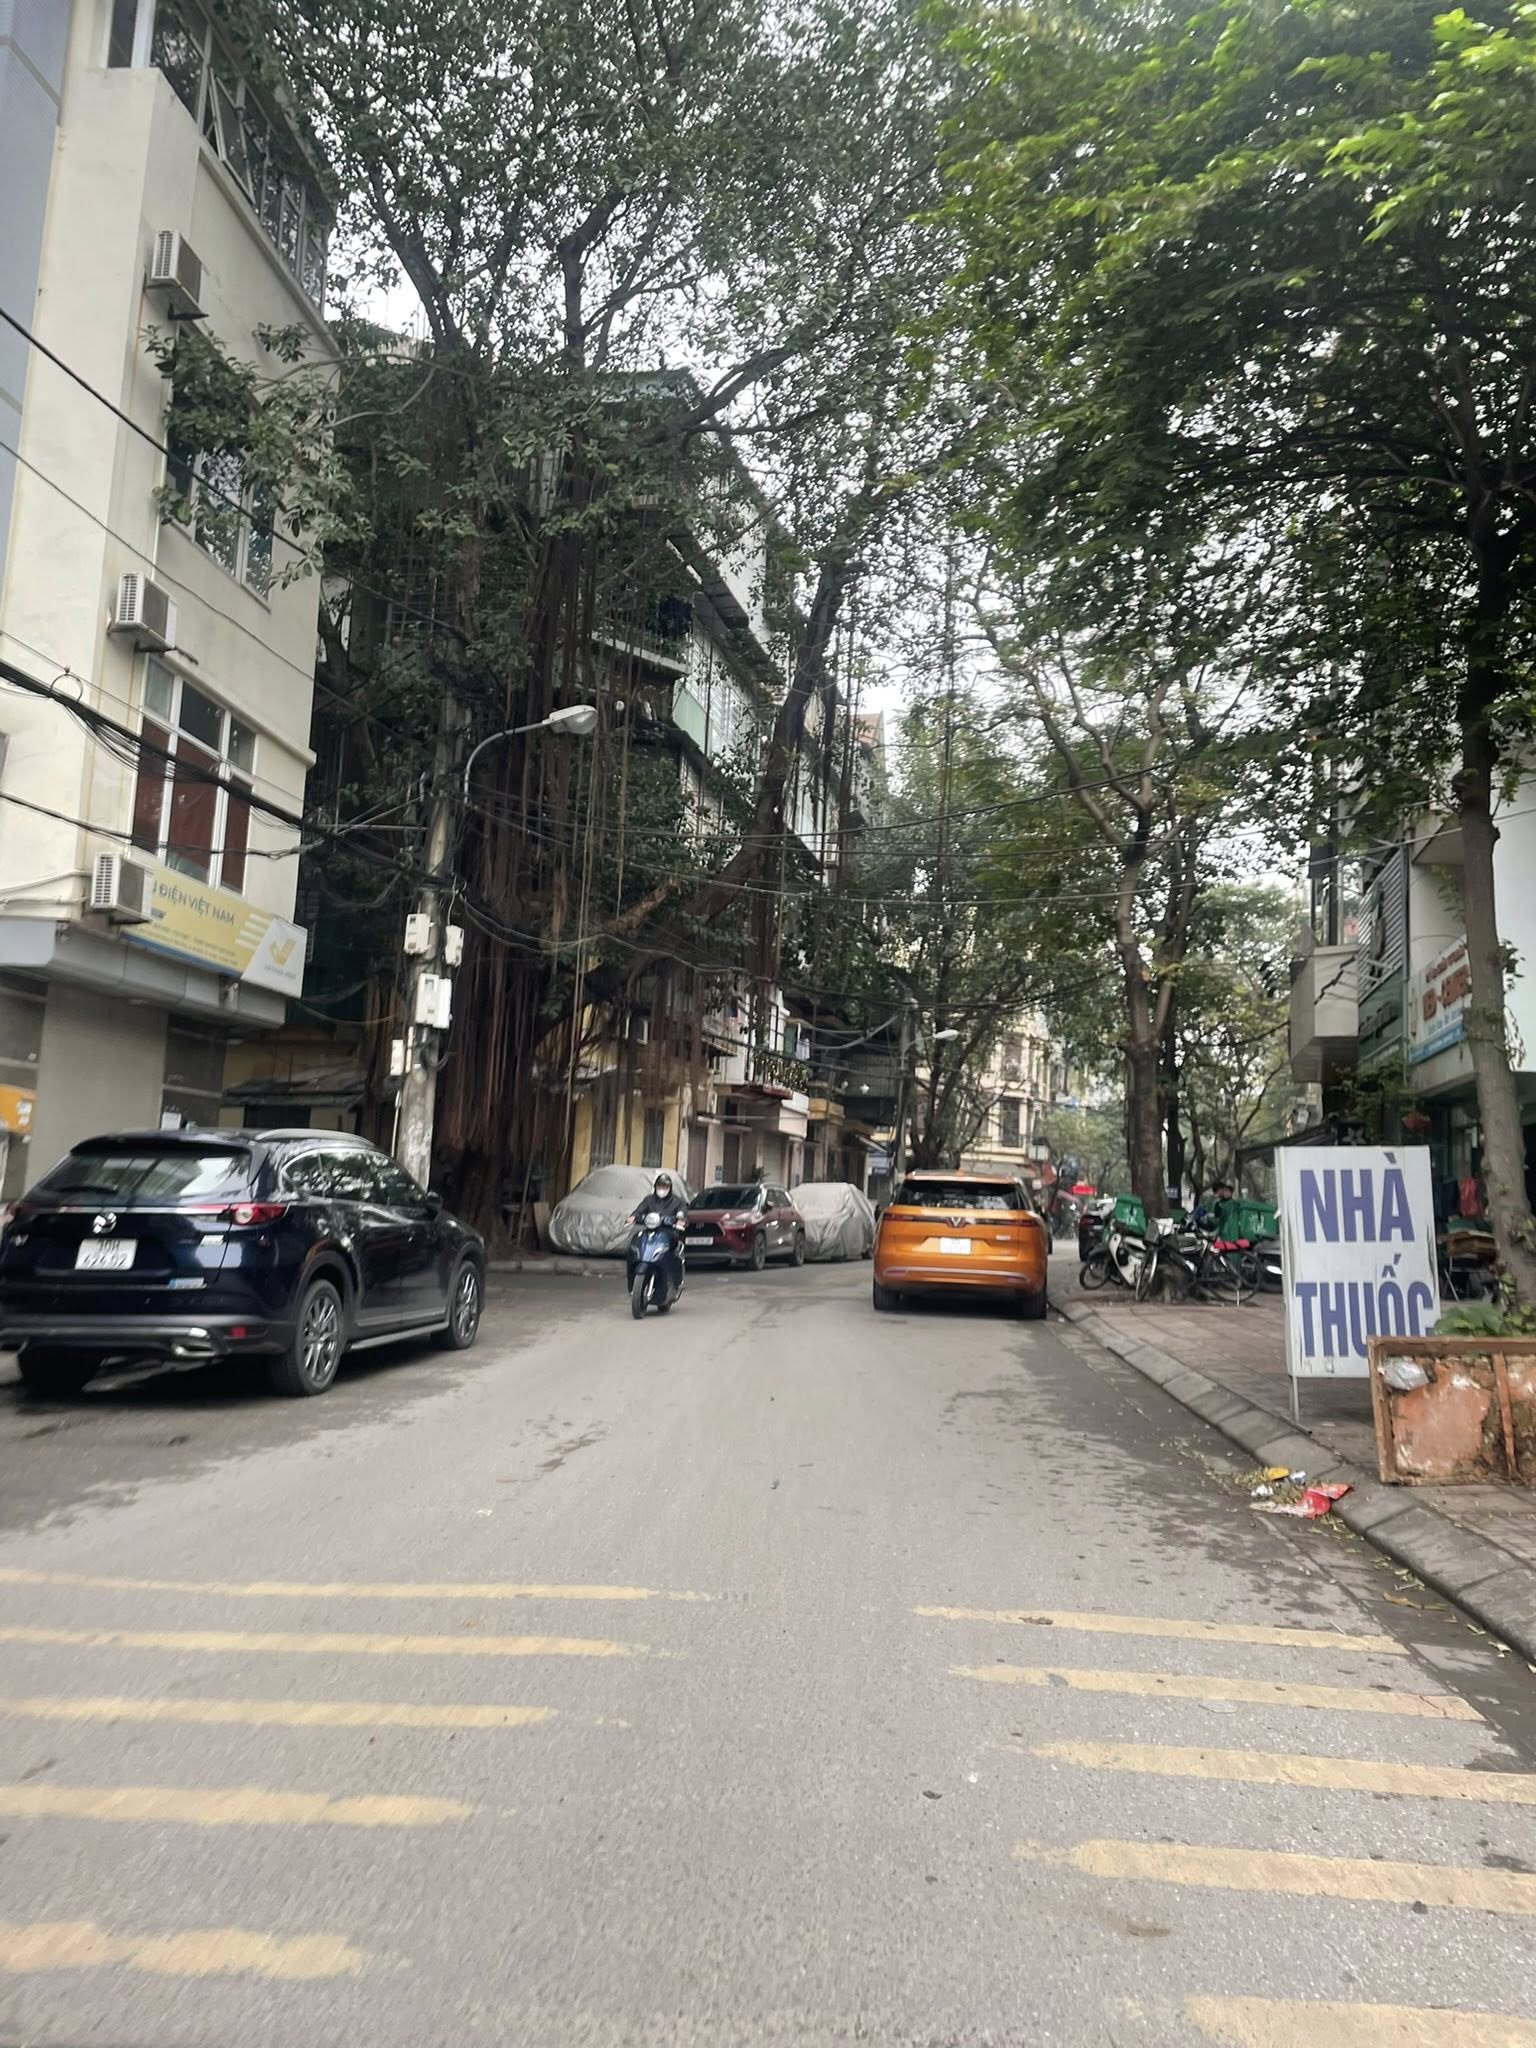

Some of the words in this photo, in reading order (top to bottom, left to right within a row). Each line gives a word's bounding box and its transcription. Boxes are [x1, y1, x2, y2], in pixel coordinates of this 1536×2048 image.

[159, 882, 187, 906] ĐIỆN
[188, 895, 211, 916] VIỆT
[211, 905, 236, 926] NAM
[1300, 1152, 1415, 1243] NHÀ
[1295, 1253, 1434, 1358] THUỐC
